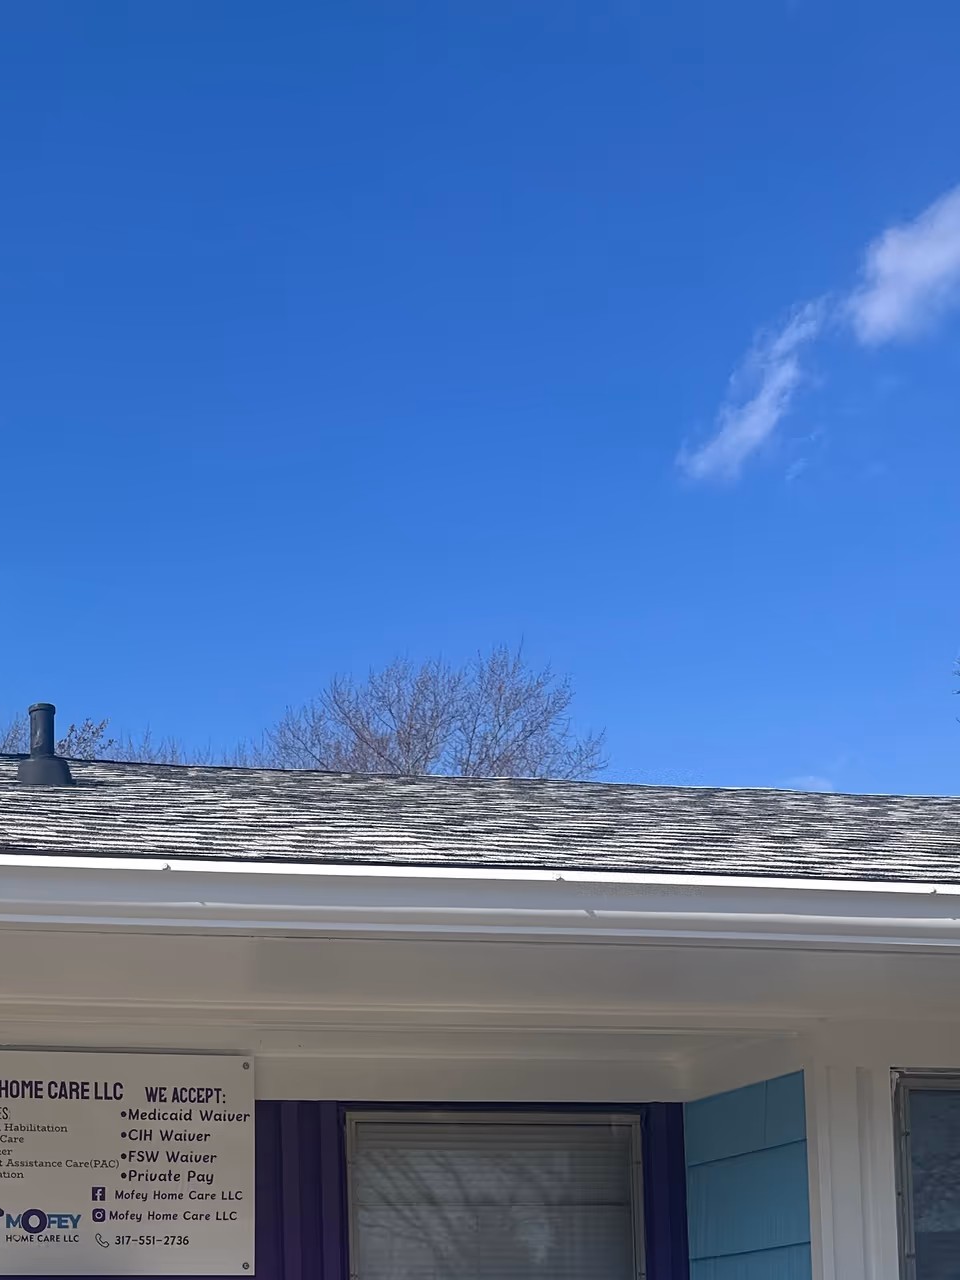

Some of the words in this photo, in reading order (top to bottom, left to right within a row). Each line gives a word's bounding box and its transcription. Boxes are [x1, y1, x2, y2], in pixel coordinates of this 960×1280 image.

[48, 1081, 90, 1100] CARE
[94, 1082, 124, 1100] LLC
[145, 1087, 167, 1103] WE
[171, 1087, 226, 1104] ACCEPT:
[128, 1109, 192, 1121] Medicaid
[199, 1109, 250, 1122] Waiver
[4, 1123, 68, 1133] Habilitation
[0, 1135, 25, 1143] Care
[160, 1129, 211, 1142] Waiver
[166, 1151, 217, 1163] Waiver
[6, 1159, 62, 1168] Assistance
[128, 1170, 181, 1182] Private
[187, 1170, 214, 1185] Pay
[115, 1190, 148, 1201] Mofey
[153, 1190, 184, 1200] Home
[189, 1191, 216, 1200] Care
[221, 1191, 243, 1201] LLC
[6, 1208, 82, 1234] MOFEY
[109, 1210, 142, 1222] Mofey
[148, 1211, 178, 1221] Home
[183, 1211, 211, 1221] Care
[216, 1211, 237, 1221] LLC
[37, 1235, 61, 1243] CARE
[63, 1235, 80, 1243] LLC
[115, 1236, 190, 1245] 317-551-2736
